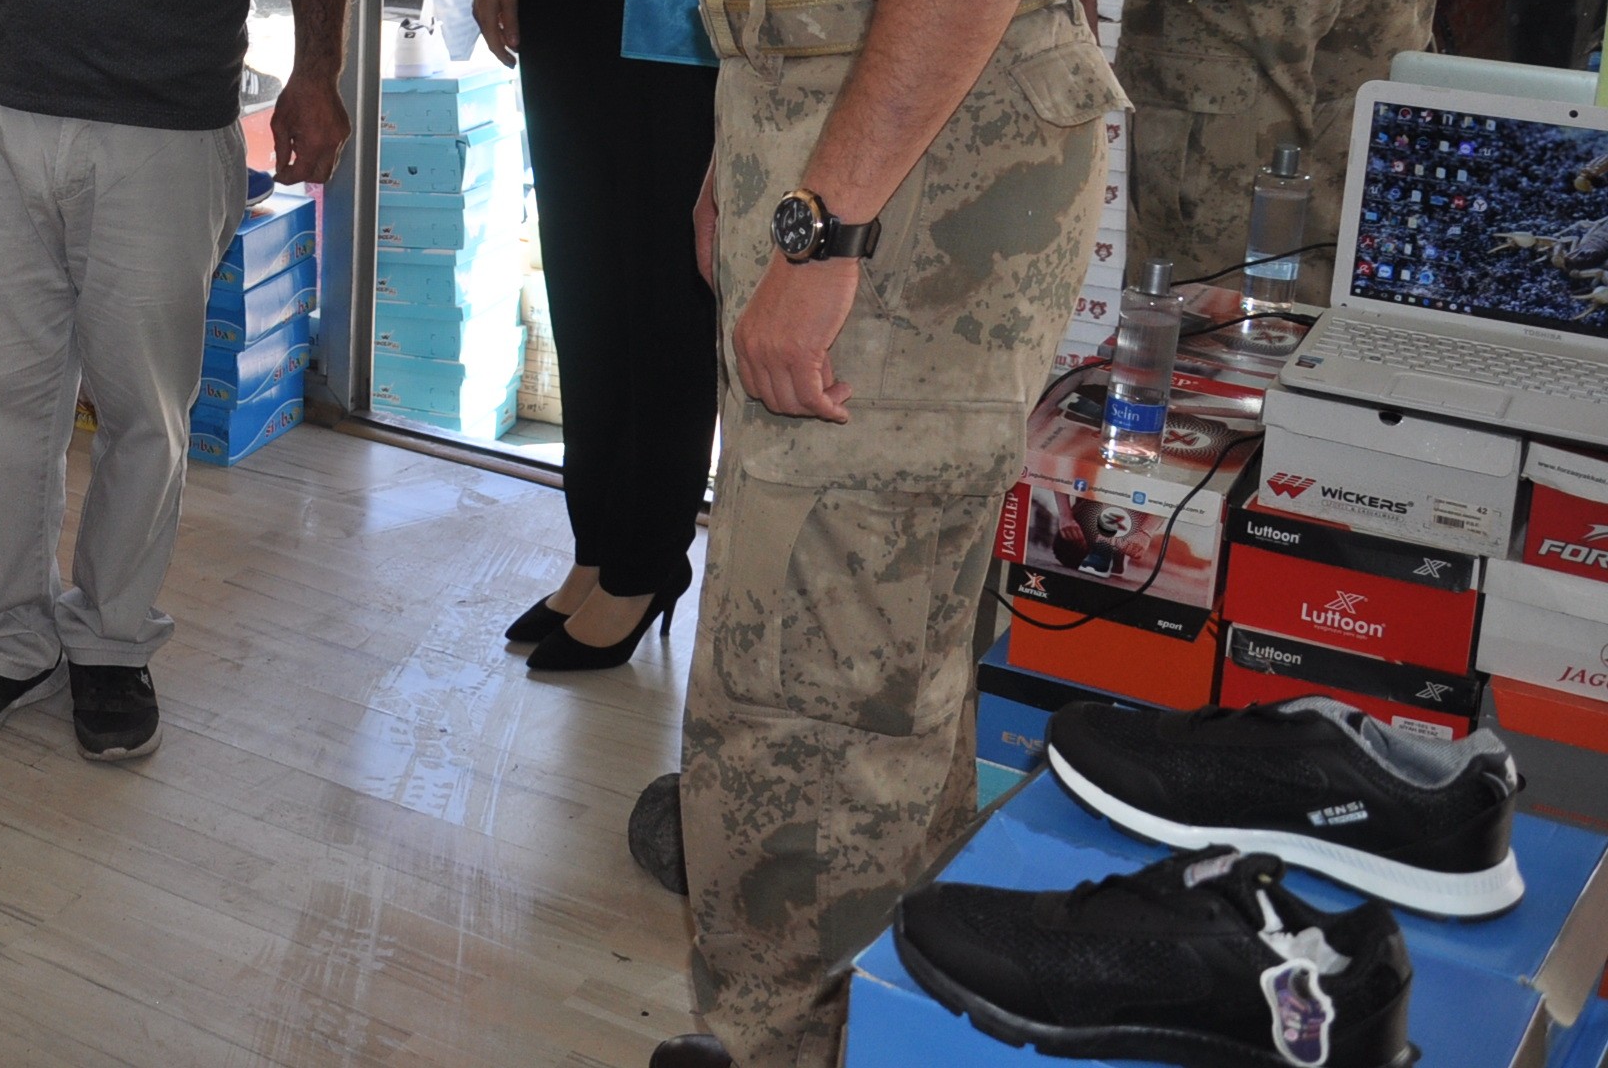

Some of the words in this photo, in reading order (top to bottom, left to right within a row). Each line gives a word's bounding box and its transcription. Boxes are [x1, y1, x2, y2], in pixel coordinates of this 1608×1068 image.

[1523, 328, 1562, 342] TOSHIBA
[1110, 403, 1140, 423] Selin
[1477, 505, 1488, 516] 42
[1002, 492, 1020, 557] JAGULEP
[1247, 522, 1299, 544] Luttoon
[1157, 619, 1184, 632] sport
[1301, 602, 1384, 638] Luttoon
[1248, 641, 1301, 665] Luttoon
